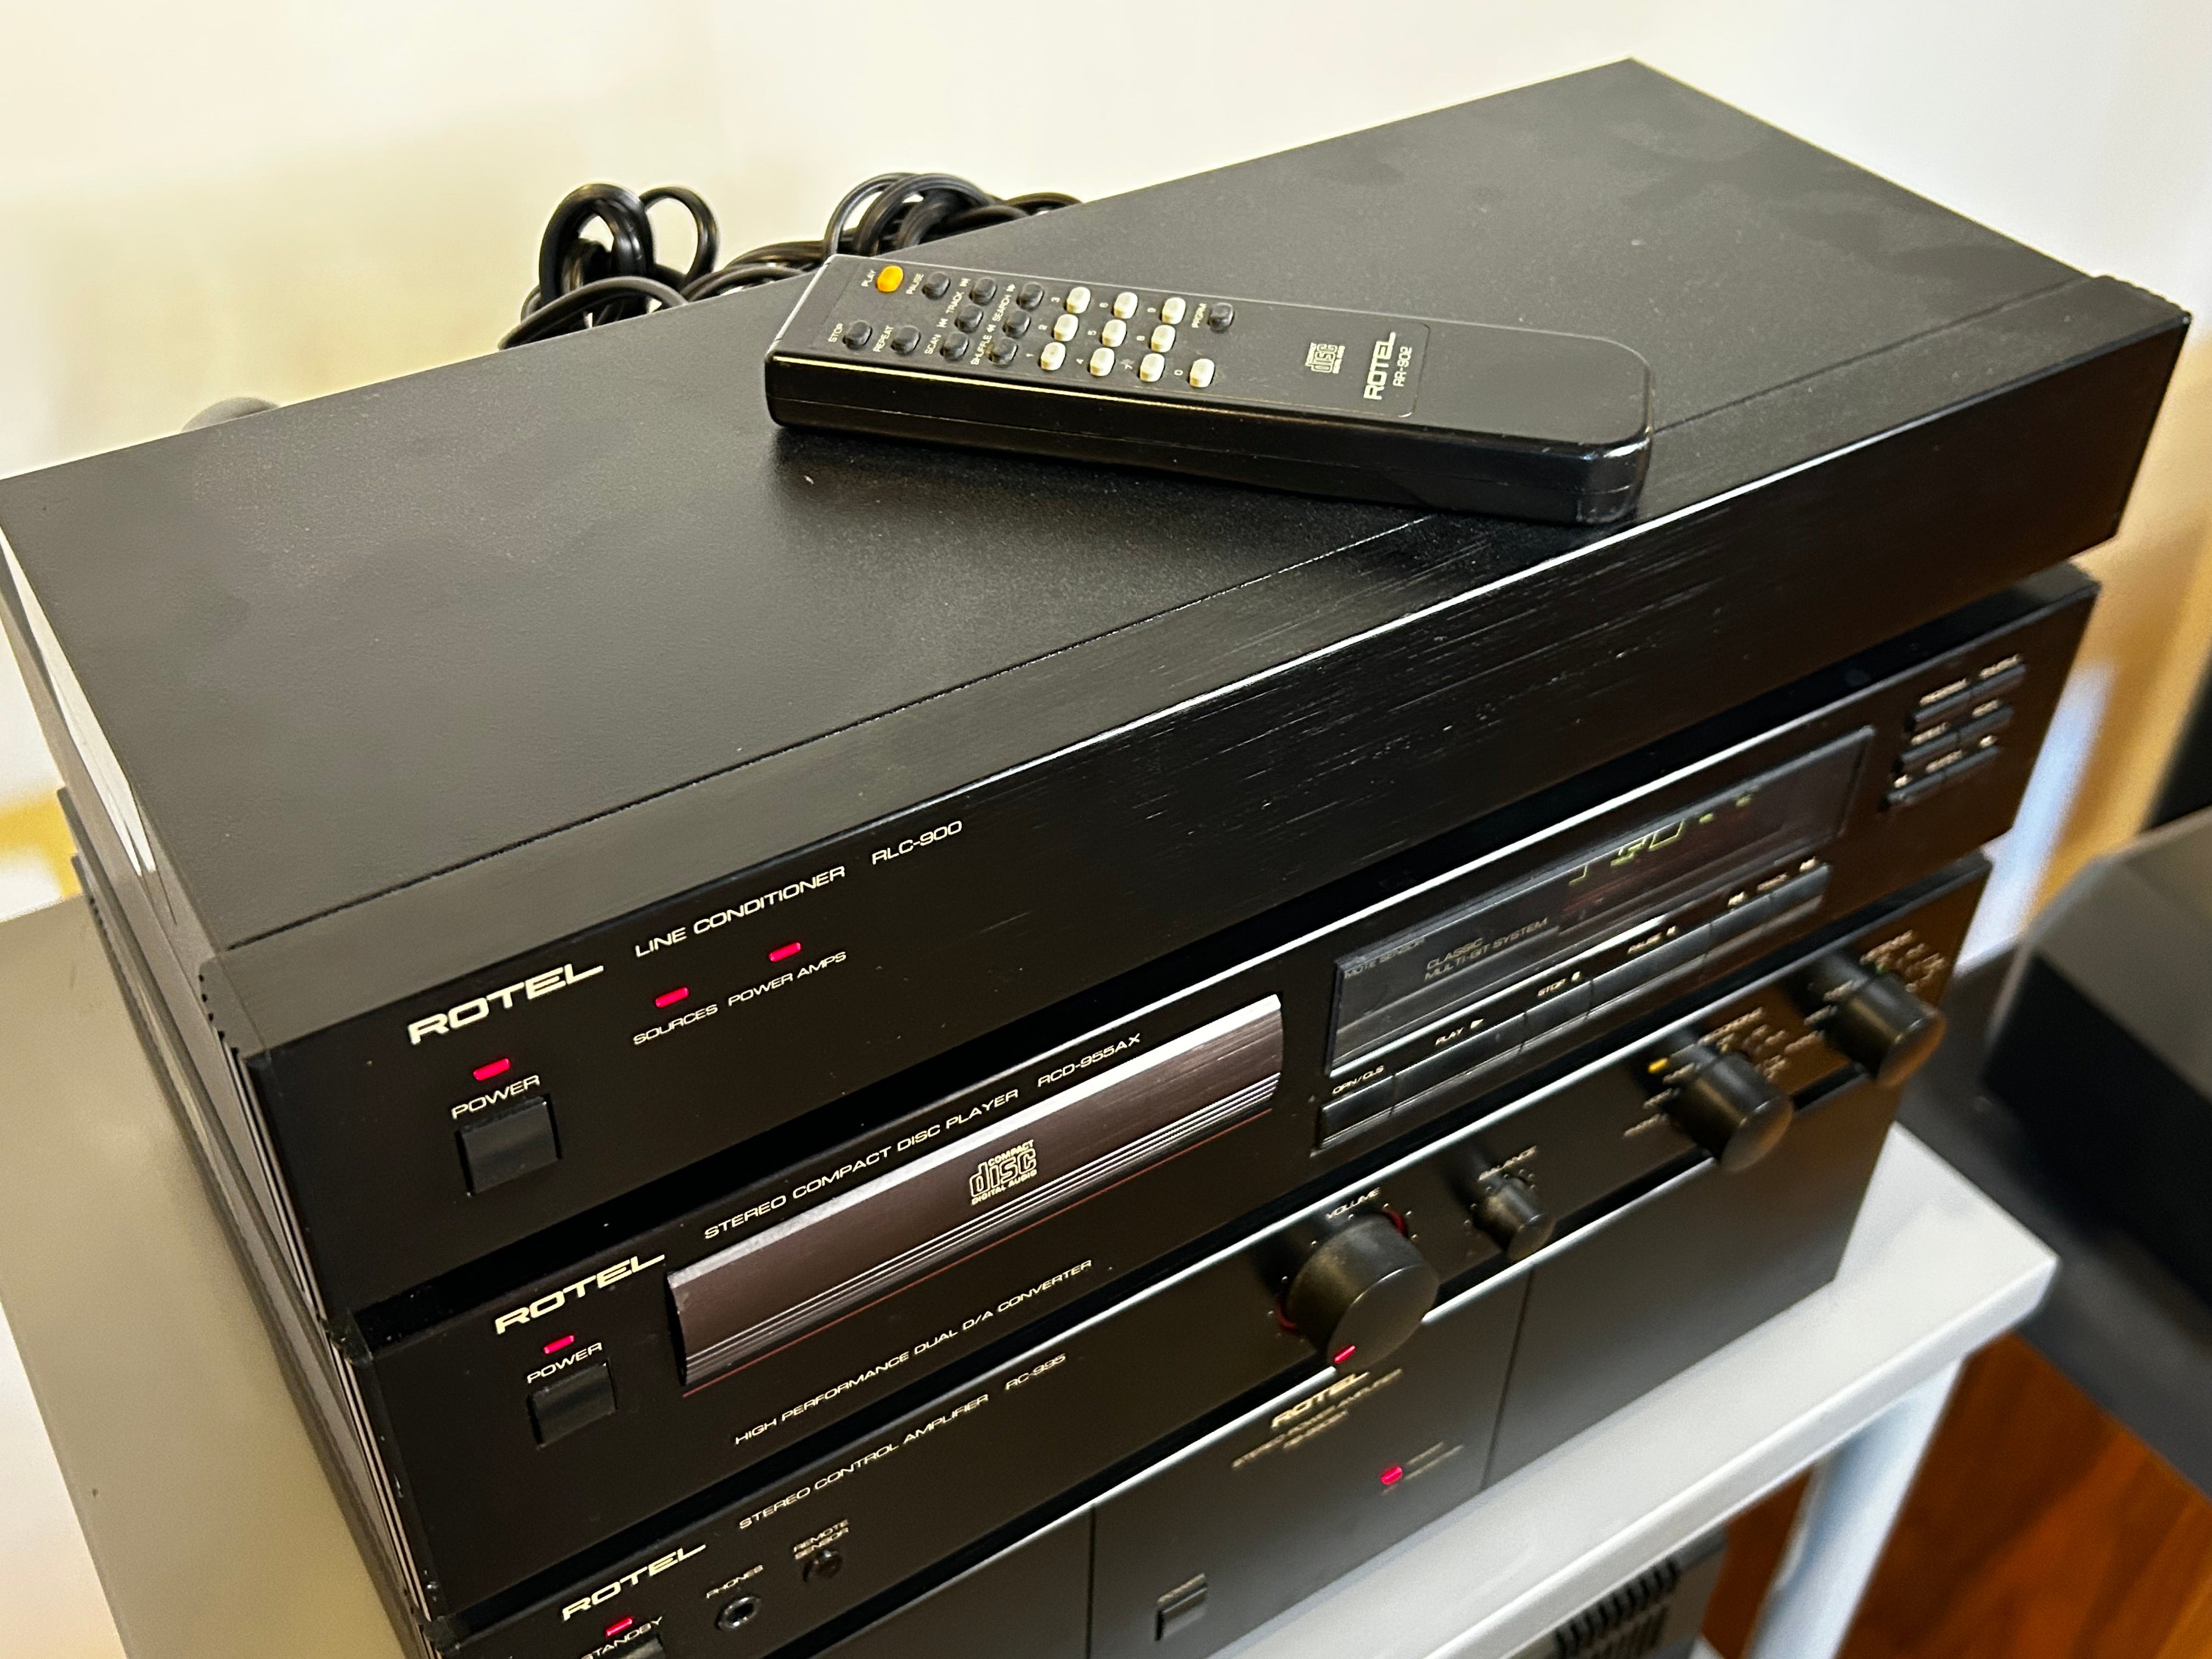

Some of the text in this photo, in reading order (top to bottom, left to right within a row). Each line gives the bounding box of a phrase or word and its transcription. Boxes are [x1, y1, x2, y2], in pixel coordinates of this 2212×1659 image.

[861, 269, 876, 287] PLAY
[906, 273, 924, 295] PAUSE
[946, 291, 964, 314] TRACK
[992, 295, 1012, 321] SEARCH
[828, 323, 843, 342] STOP
[873, 325, 894, 352] REPEAT
[924, 334, 941, 354] SCAN
[970, 334, 992, 365] SHUFFLE
[1363, 331, 1396, 400] ROTEL
[1392, 346, 1413, 387] RR-902
[635, 820, 963, 958] LINE CONDITIONER RLC-900
[1424, 917, 1548, 982] MULTI-BIT SYSTEM
[1427, 938, 1483, 970] CLASSIC
[727, 951, 847, 1006] POWER AMPS
[408, 962, 604, 1046] ROTEL
[633, 1005, 719, 1046] SOURCES
[1435, 1028, 1464, 1046] PLAY
[451, 1075, 540, 1120] POWER
[1331, 1065, 1384, 1096] OPN/CLS
[704, 1032, 1142, 1240] STEREO COMPACT DISC PLAYER RCD-955AX
[988, 1139, 1034, 1166] COMPACT
[969, 1148, 1037, 1198] disc
[971, 1169, 1037, 1205] DIGITAL AUDIO
[495, 1254, 665, 1335] ROTEL
[527, 1342, 603, 1384] POWER
[735, 1259, 1093, 1445] HIGH PERFORMANCE DUAL D/A CONVERTER
[1271, 1372, 1370, 1429] ROTEL
[739, 1353, 1066, 1530] STEREO CONTROL AMPLIFIER RC-995
[562, 1543, 707, 1622] ROTEL
[706, 1565, 764, 1599] PHONES
